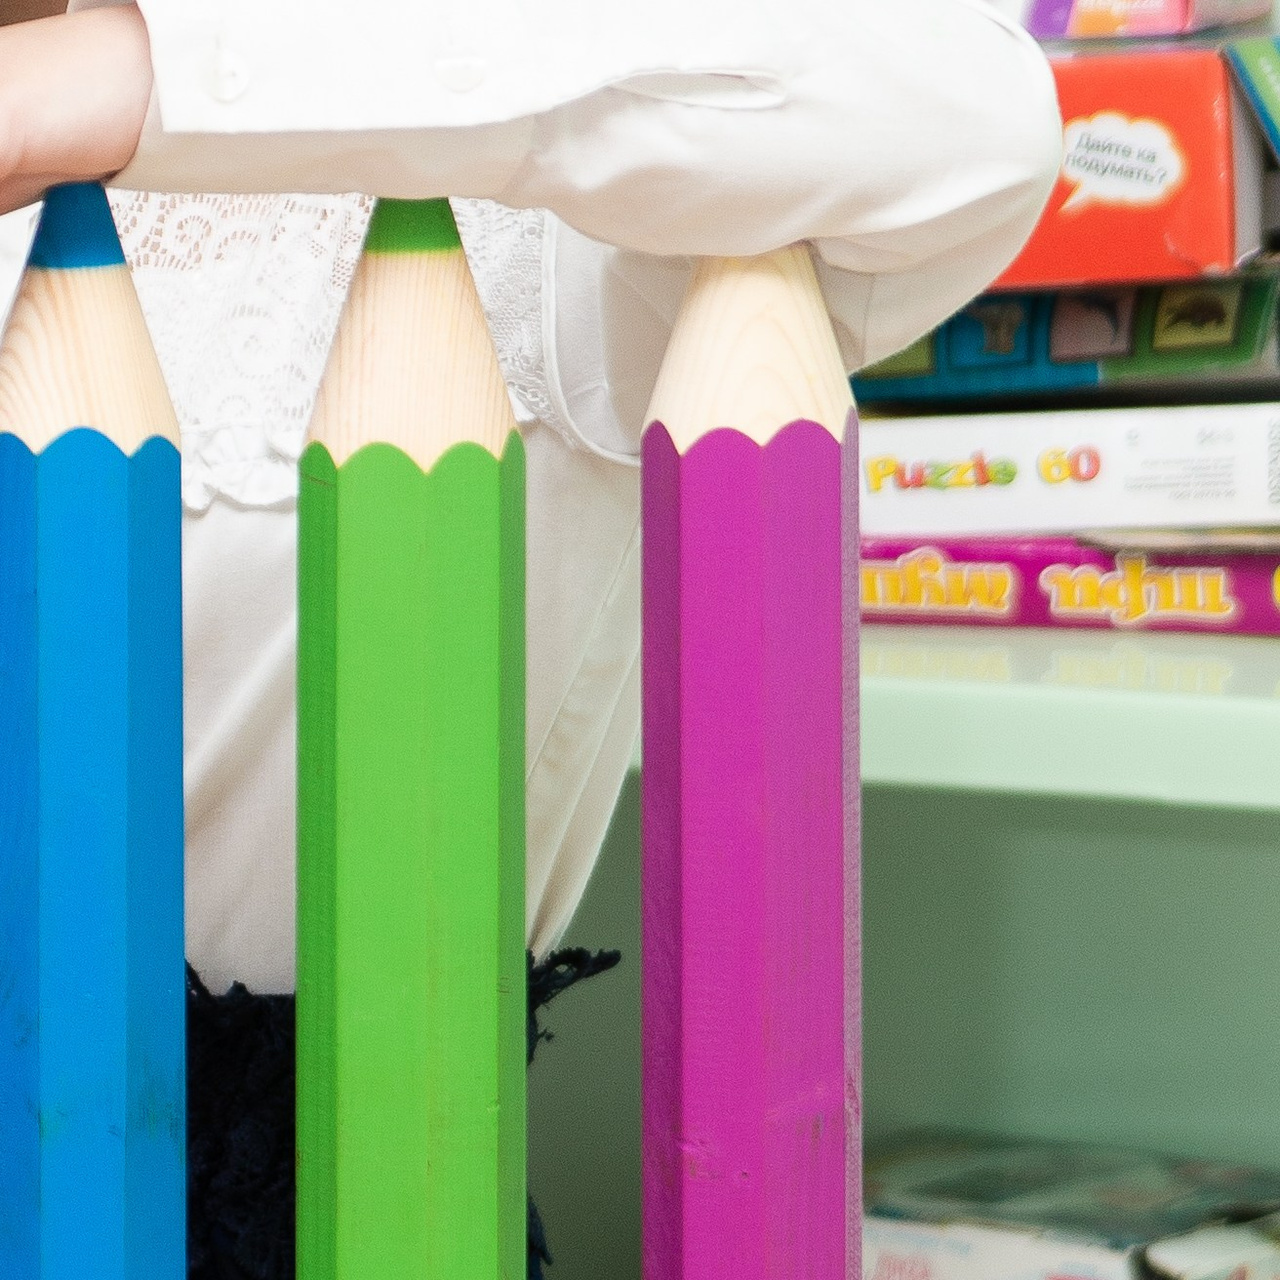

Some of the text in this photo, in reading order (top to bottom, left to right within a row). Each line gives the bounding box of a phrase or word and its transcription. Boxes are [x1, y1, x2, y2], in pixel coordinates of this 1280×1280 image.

[1075, 132, 1132, 158] Дайте
[1065, 152, 1168, 184] подумать?
[866, 453, 1018, 493] Puzzle
[1037, 446, 1102, 483] 60
